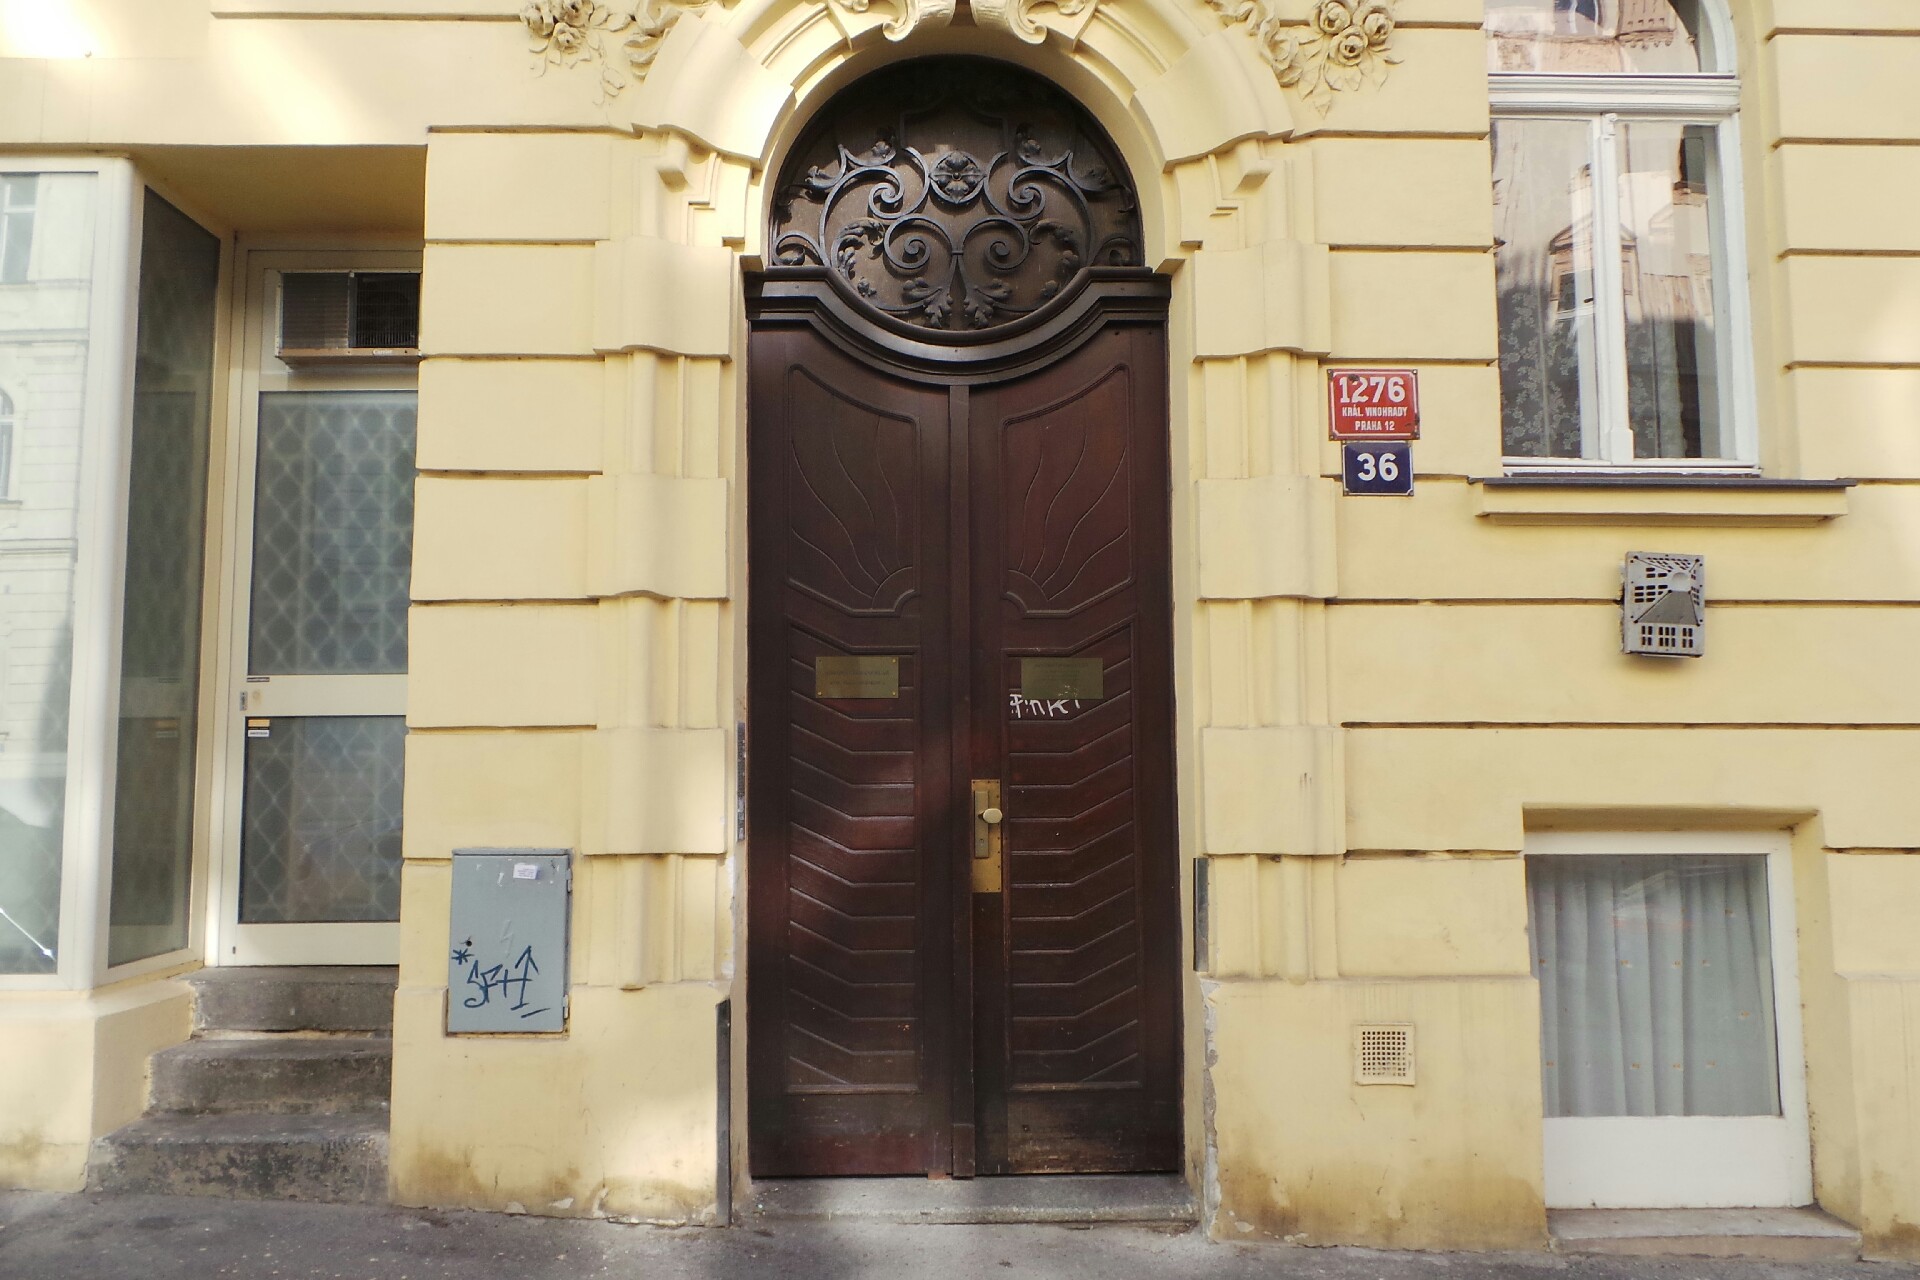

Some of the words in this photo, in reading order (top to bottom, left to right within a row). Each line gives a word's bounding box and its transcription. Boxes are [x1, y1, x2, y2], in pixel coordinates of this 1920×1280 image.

[1339, 376, 1406, 403] 1276
[1342, 404, 1364, 417] KRÁL.
[1365, 406, 1408, 417] VINOHRADY
[1355, 420, 1382, 431] PRAHA
[1384, 420, 1395, 431] 12
[1357, 452, 1399, 481] 36
